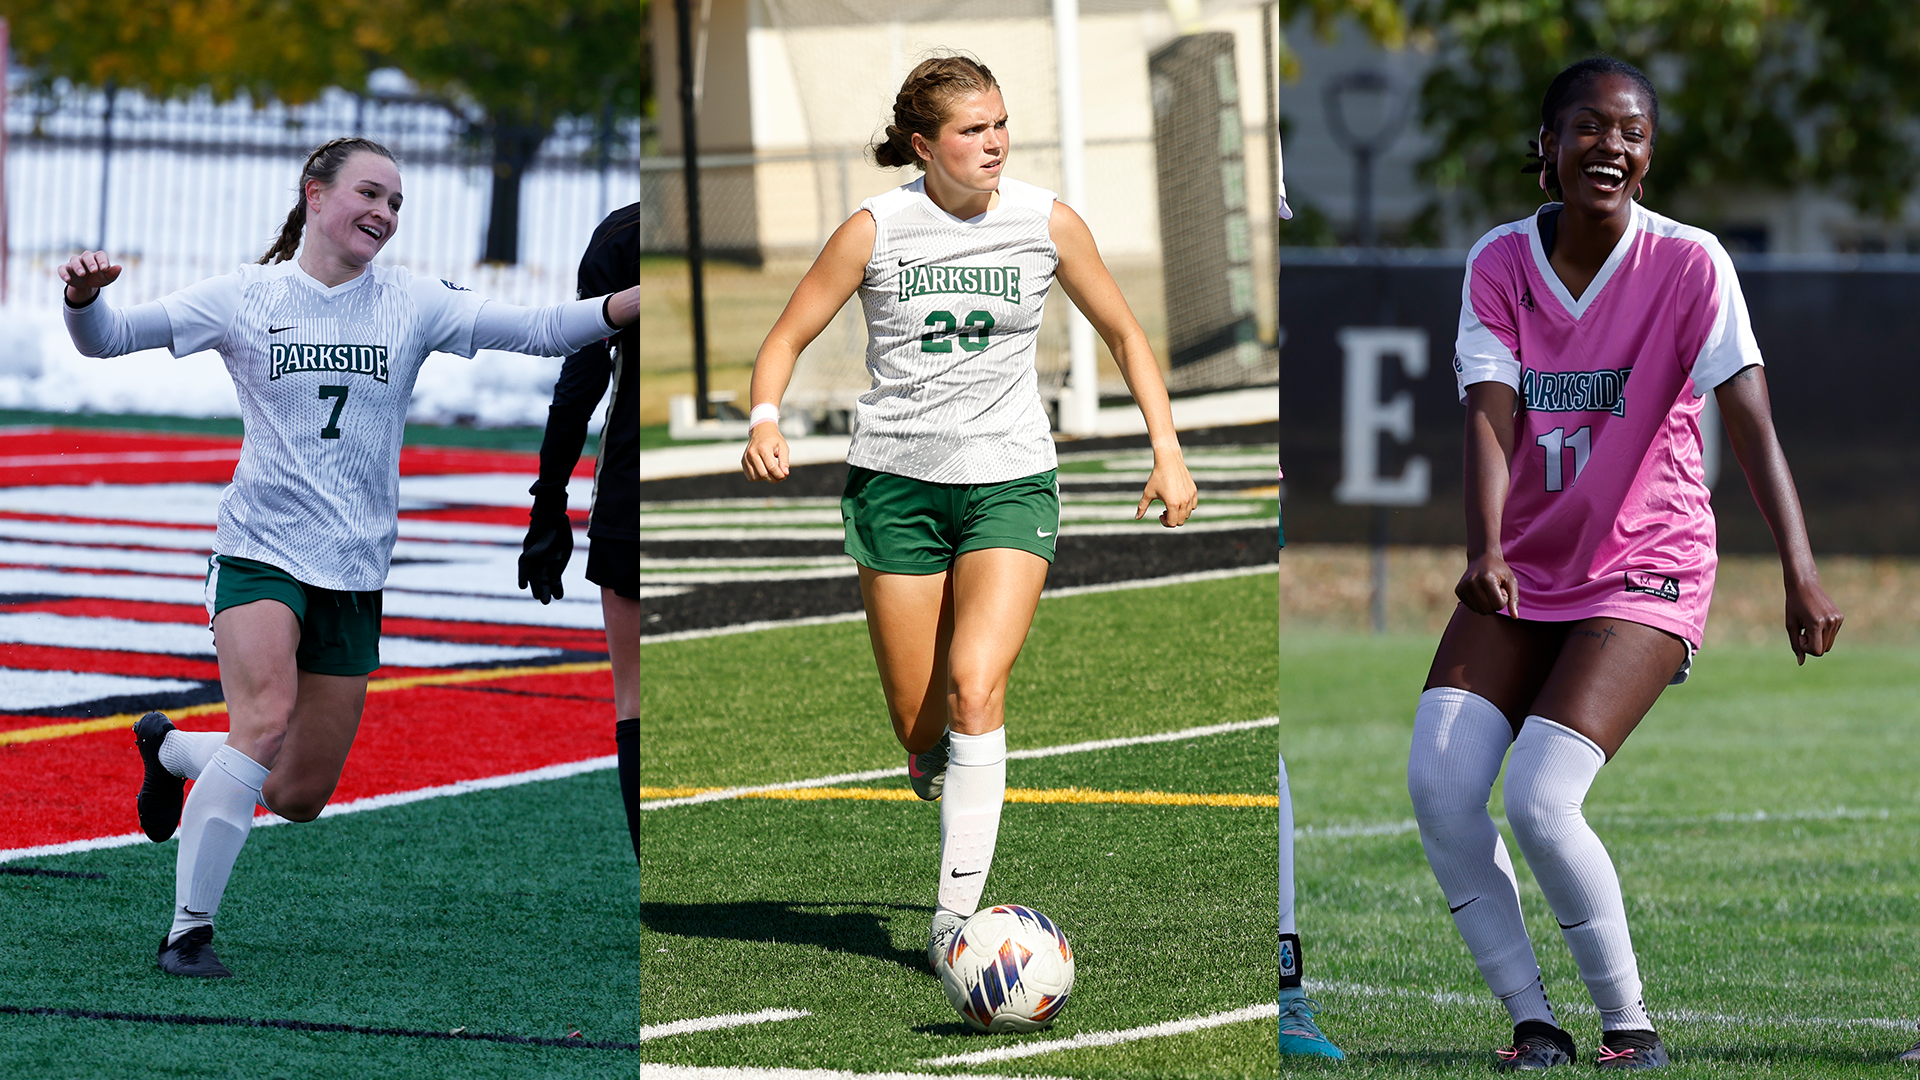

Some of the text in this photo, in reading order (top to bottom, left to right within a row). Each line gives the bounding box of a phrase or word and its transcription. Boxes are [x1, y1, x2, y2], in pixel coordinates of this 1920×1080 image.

[898, 265, 1021, 305] PARKSIDE
[921, 310, 995, 353] 23
[270, 343, 389, 384] PARKSIDE
[318, 385, 349, 439] 7
[1522, 366, 1633, 418] ARKSID
[1536, 425, 1592, 492] 11
